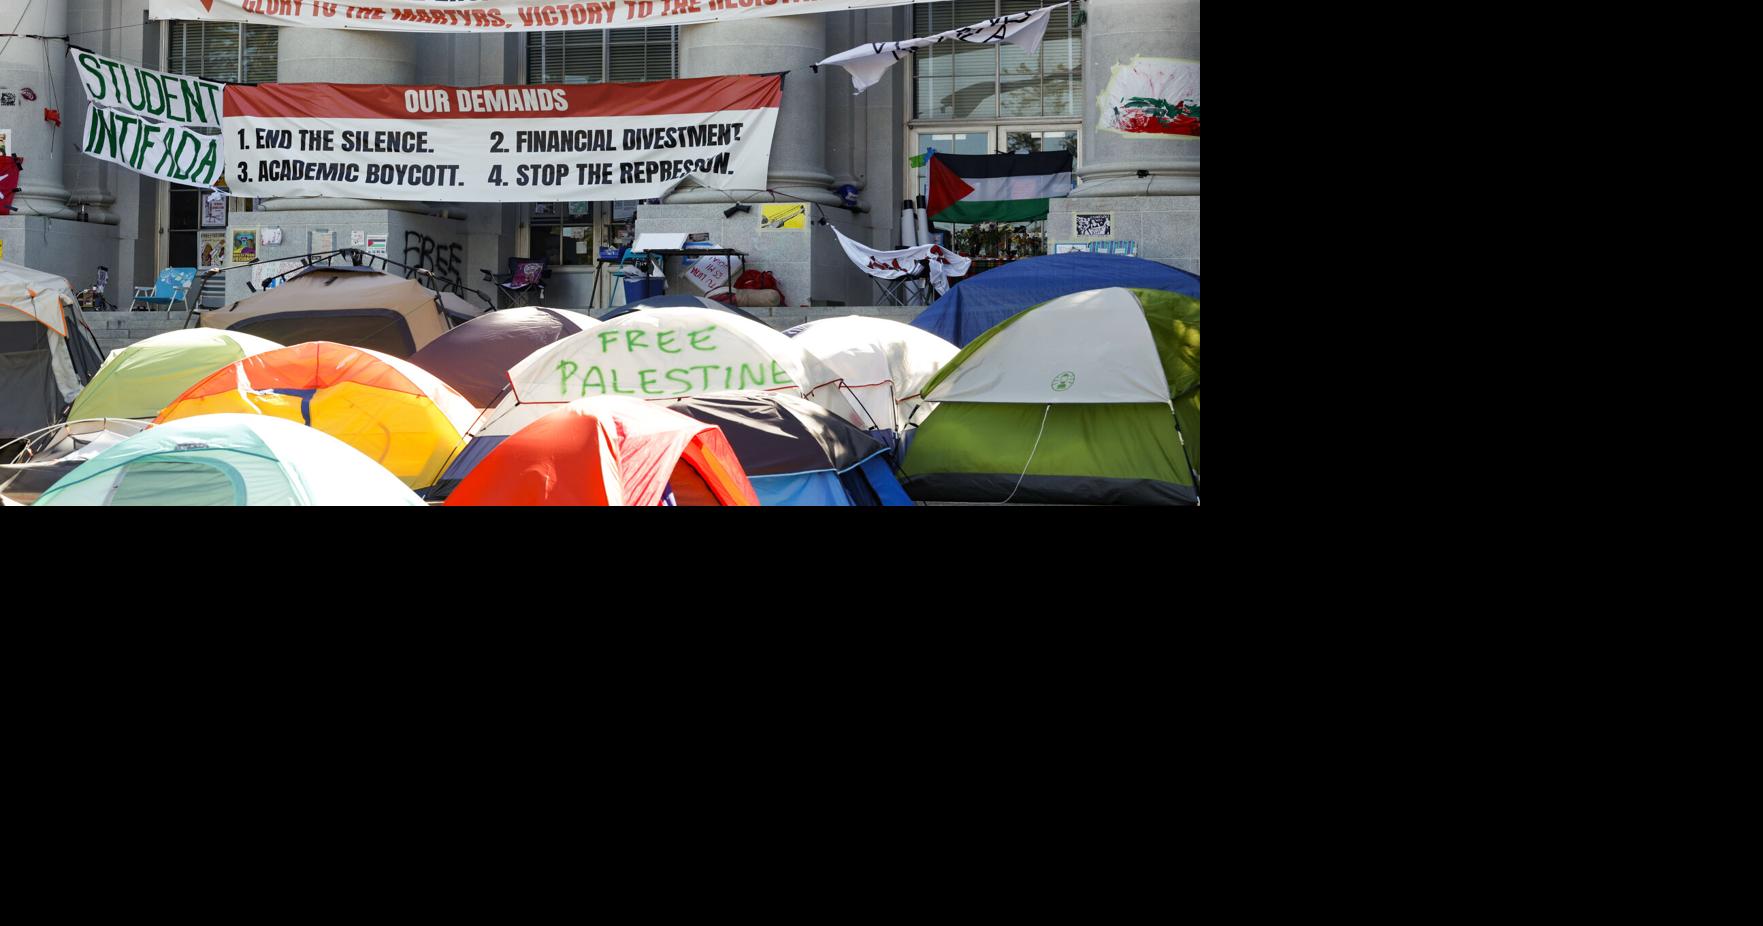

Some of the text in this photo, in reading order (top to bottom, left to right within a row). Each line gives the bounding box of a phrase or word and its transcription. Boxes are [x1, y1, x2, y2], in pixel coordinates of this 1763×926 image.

[242, 0, 302, 16] GLORY
[312, 0, 338, 17] TO
[391, 8, 513, 29] MARTYRS,
[517, 1, 616, 28] VICTORY
[624, 0, 651, 20] TO
[78, 53, 220, 125] STUDENT
[404, 88, 569, 113] OUR DEMANDS
[86, 107, 218, 184] INTIFADA
[237, 128, 435, 154] 1. END THE SILENCE.
[489, 122, 744, 153] 2. FINANCIAL DIVESTMENT
[237, 159, 465, 187] 3. ACADEMIC BOYCOTT.
[487, 164, 509, 187] 4.
[516, 163, 570, 187] STOP
[576, 163, 613, 186] THE
[403, 230, 463, 277] FREE
[598, 324, 719, 354] FREE
[555, 358, 793, 397] PALESTINE
